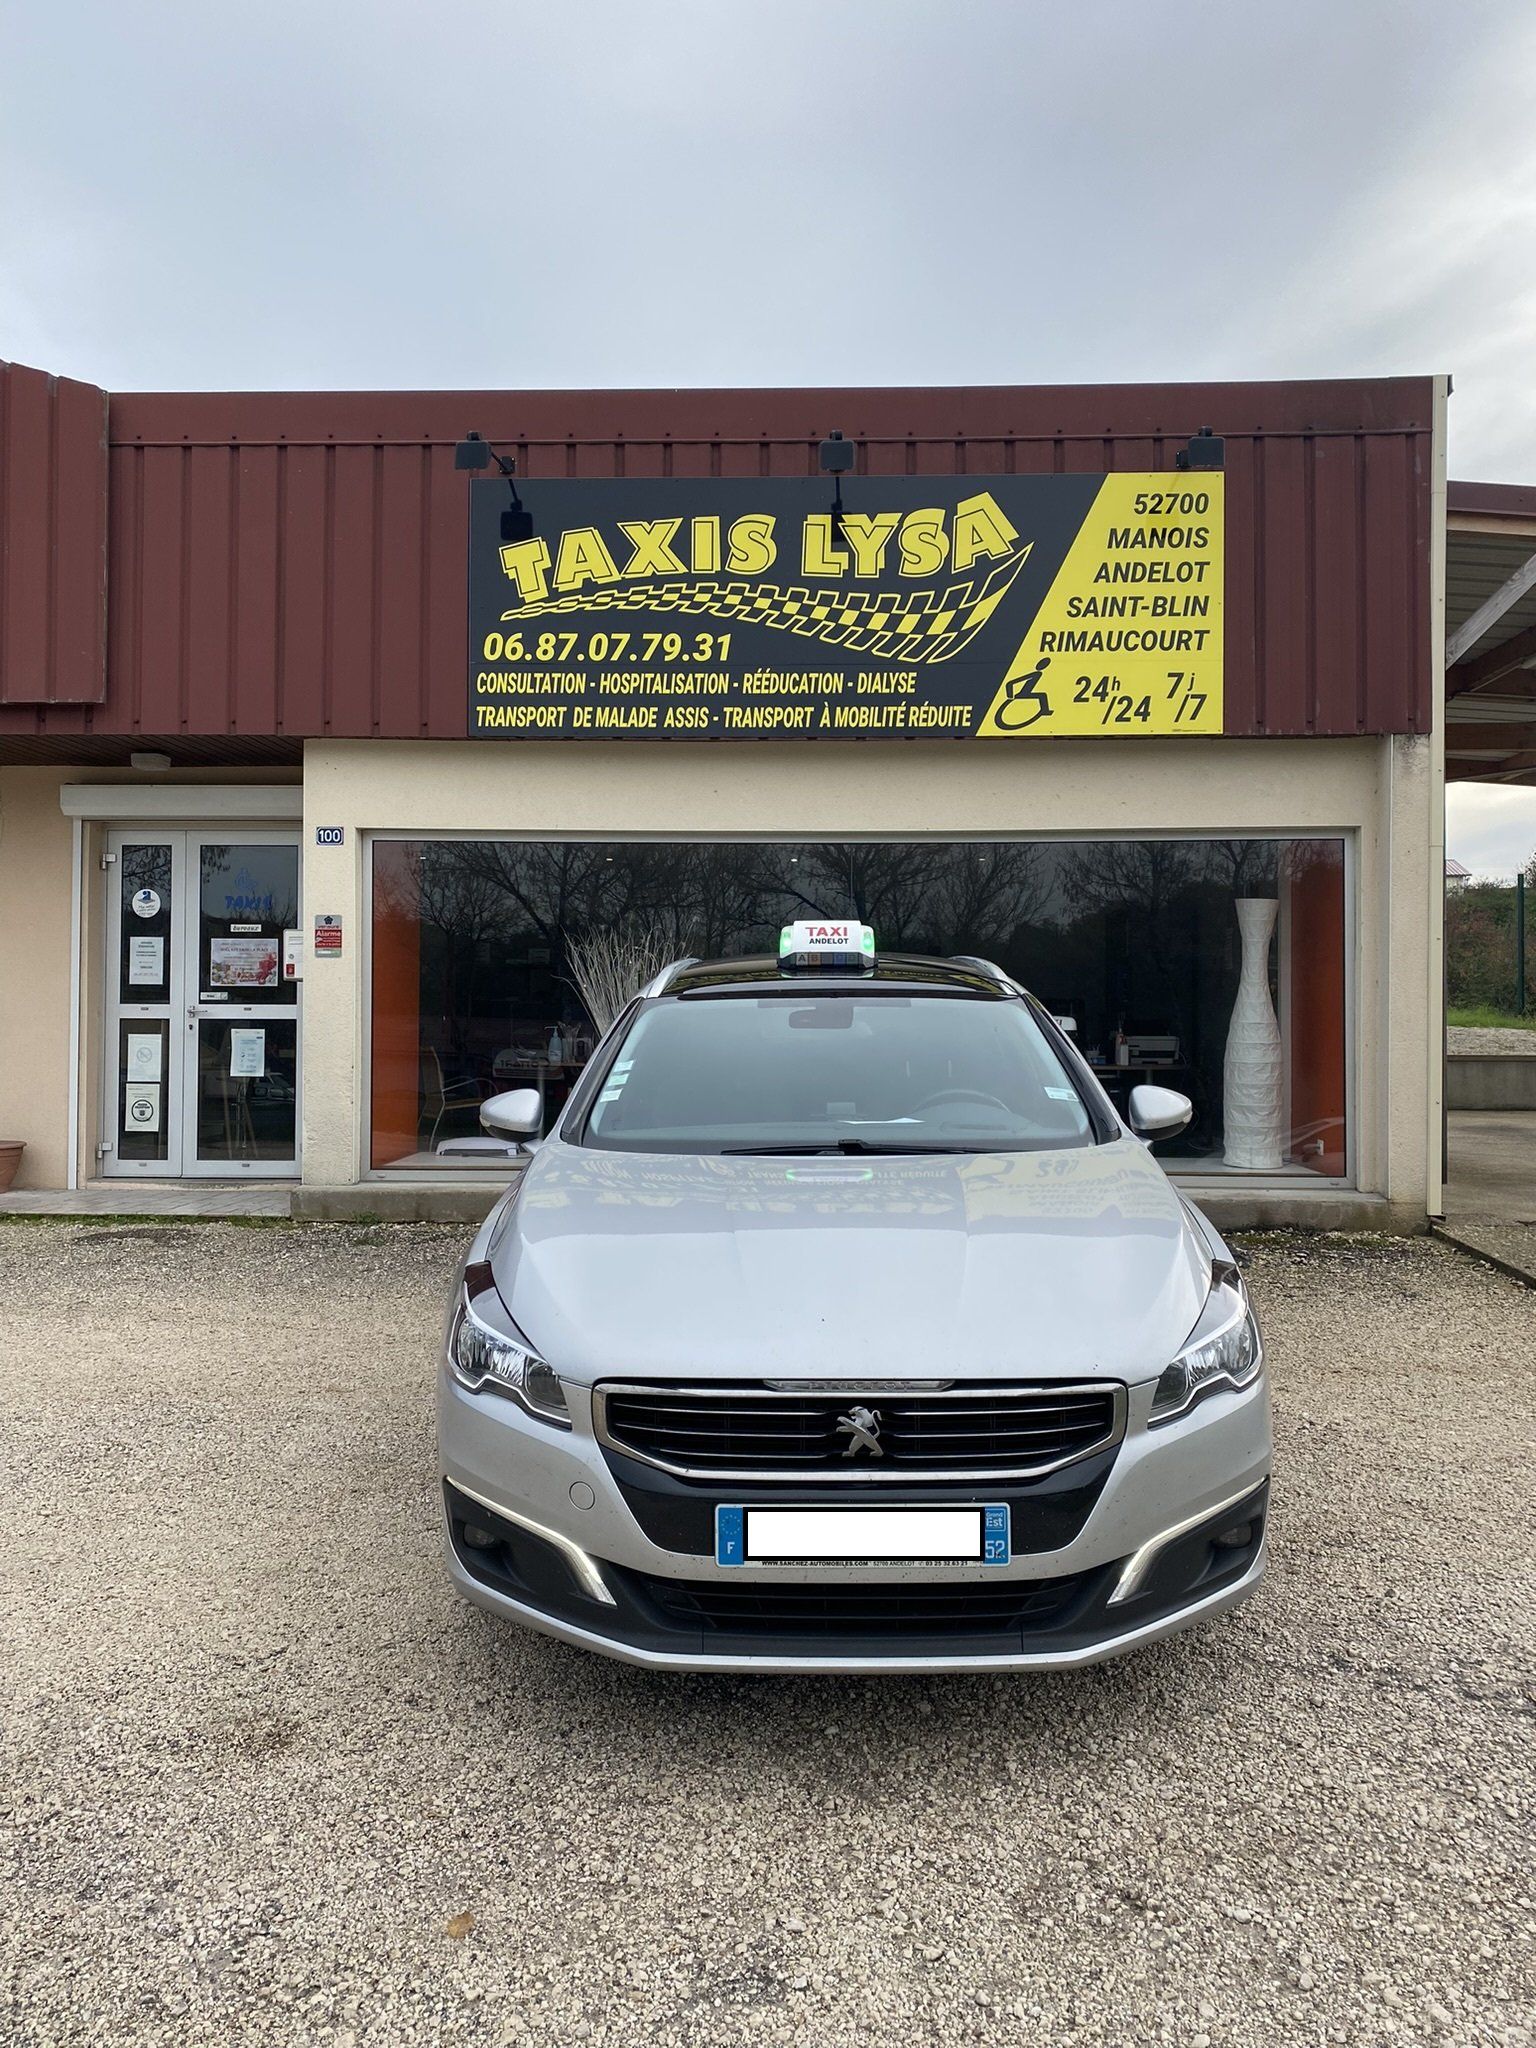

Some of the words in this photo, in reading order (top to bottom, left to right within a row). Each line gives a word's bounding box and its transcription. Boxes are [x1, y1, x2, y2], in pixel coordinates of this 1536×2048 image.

[1134, 492, 1210, 515] 52700
[499, 514, 777, 604] TAXIS
[801, 491, 1021, 578] LYSA
[1106, 526, 1210, 550] MANOIS
[1093, 560, 1211, 584] ANDELOT
[1066, 594, 1210, 618] SAINT-BLIN
[483, 632, 732, 662] 06.87.07.79.31
[1039, 629, 1211, 653] RIMAUCOURT
[476, 672, 587, 695] CONSULTATION
[599, 672, 730, 695] HOSPITALISATION
[742, 667, 844, 695] RÉÉDUCATION
[856, 671, 918, 695] DIALYSE
[476, 705, 567, 728] TRANSPORT
[572, 706, 592, 728] DE
[595, 706, 658, 728] MALADE
[663, 706, 710, 729] ASSIS
[723, 706, 815, 729] TRANSPORT
[819, 702, 832, 728] À
[835, 701, 906, 728] MOBILITÉ
[907, 701, 973, 728] RÉDUITE
[318, 829, 341, 843] 100
[805, 927, 848, 937] TAXI
[798, 954, 806, 962] A
[986, 1517, 1003, 1527] Est
[726, 1541, 735, 1554] F
[985, 1540, 1005, 1559] 52
